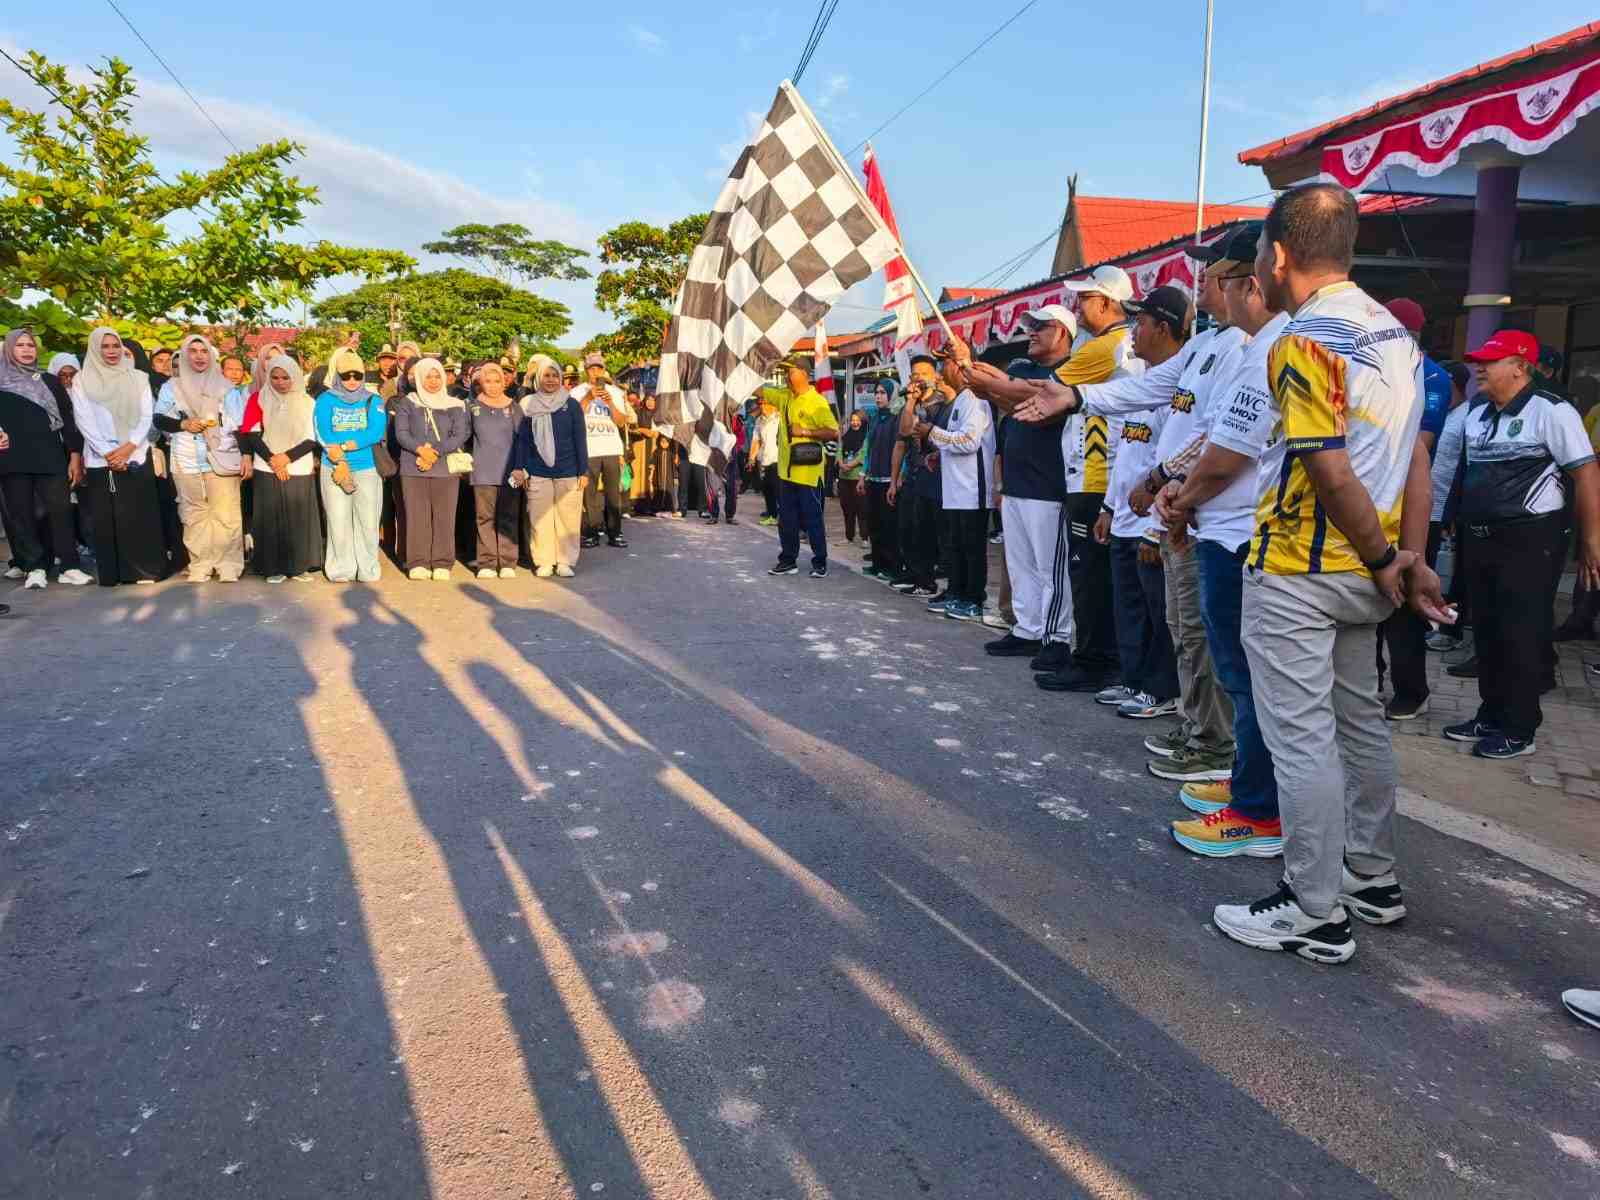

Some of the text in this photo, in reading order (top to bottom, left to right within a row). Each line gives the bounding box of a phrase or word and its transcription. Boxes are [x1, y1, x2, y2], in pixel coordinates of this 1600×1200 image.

[1233, 391, 1266, 412] IWC
[1229, 405, 1252, 419] AMD
[1220, 825, 1254, 839] HOKA
